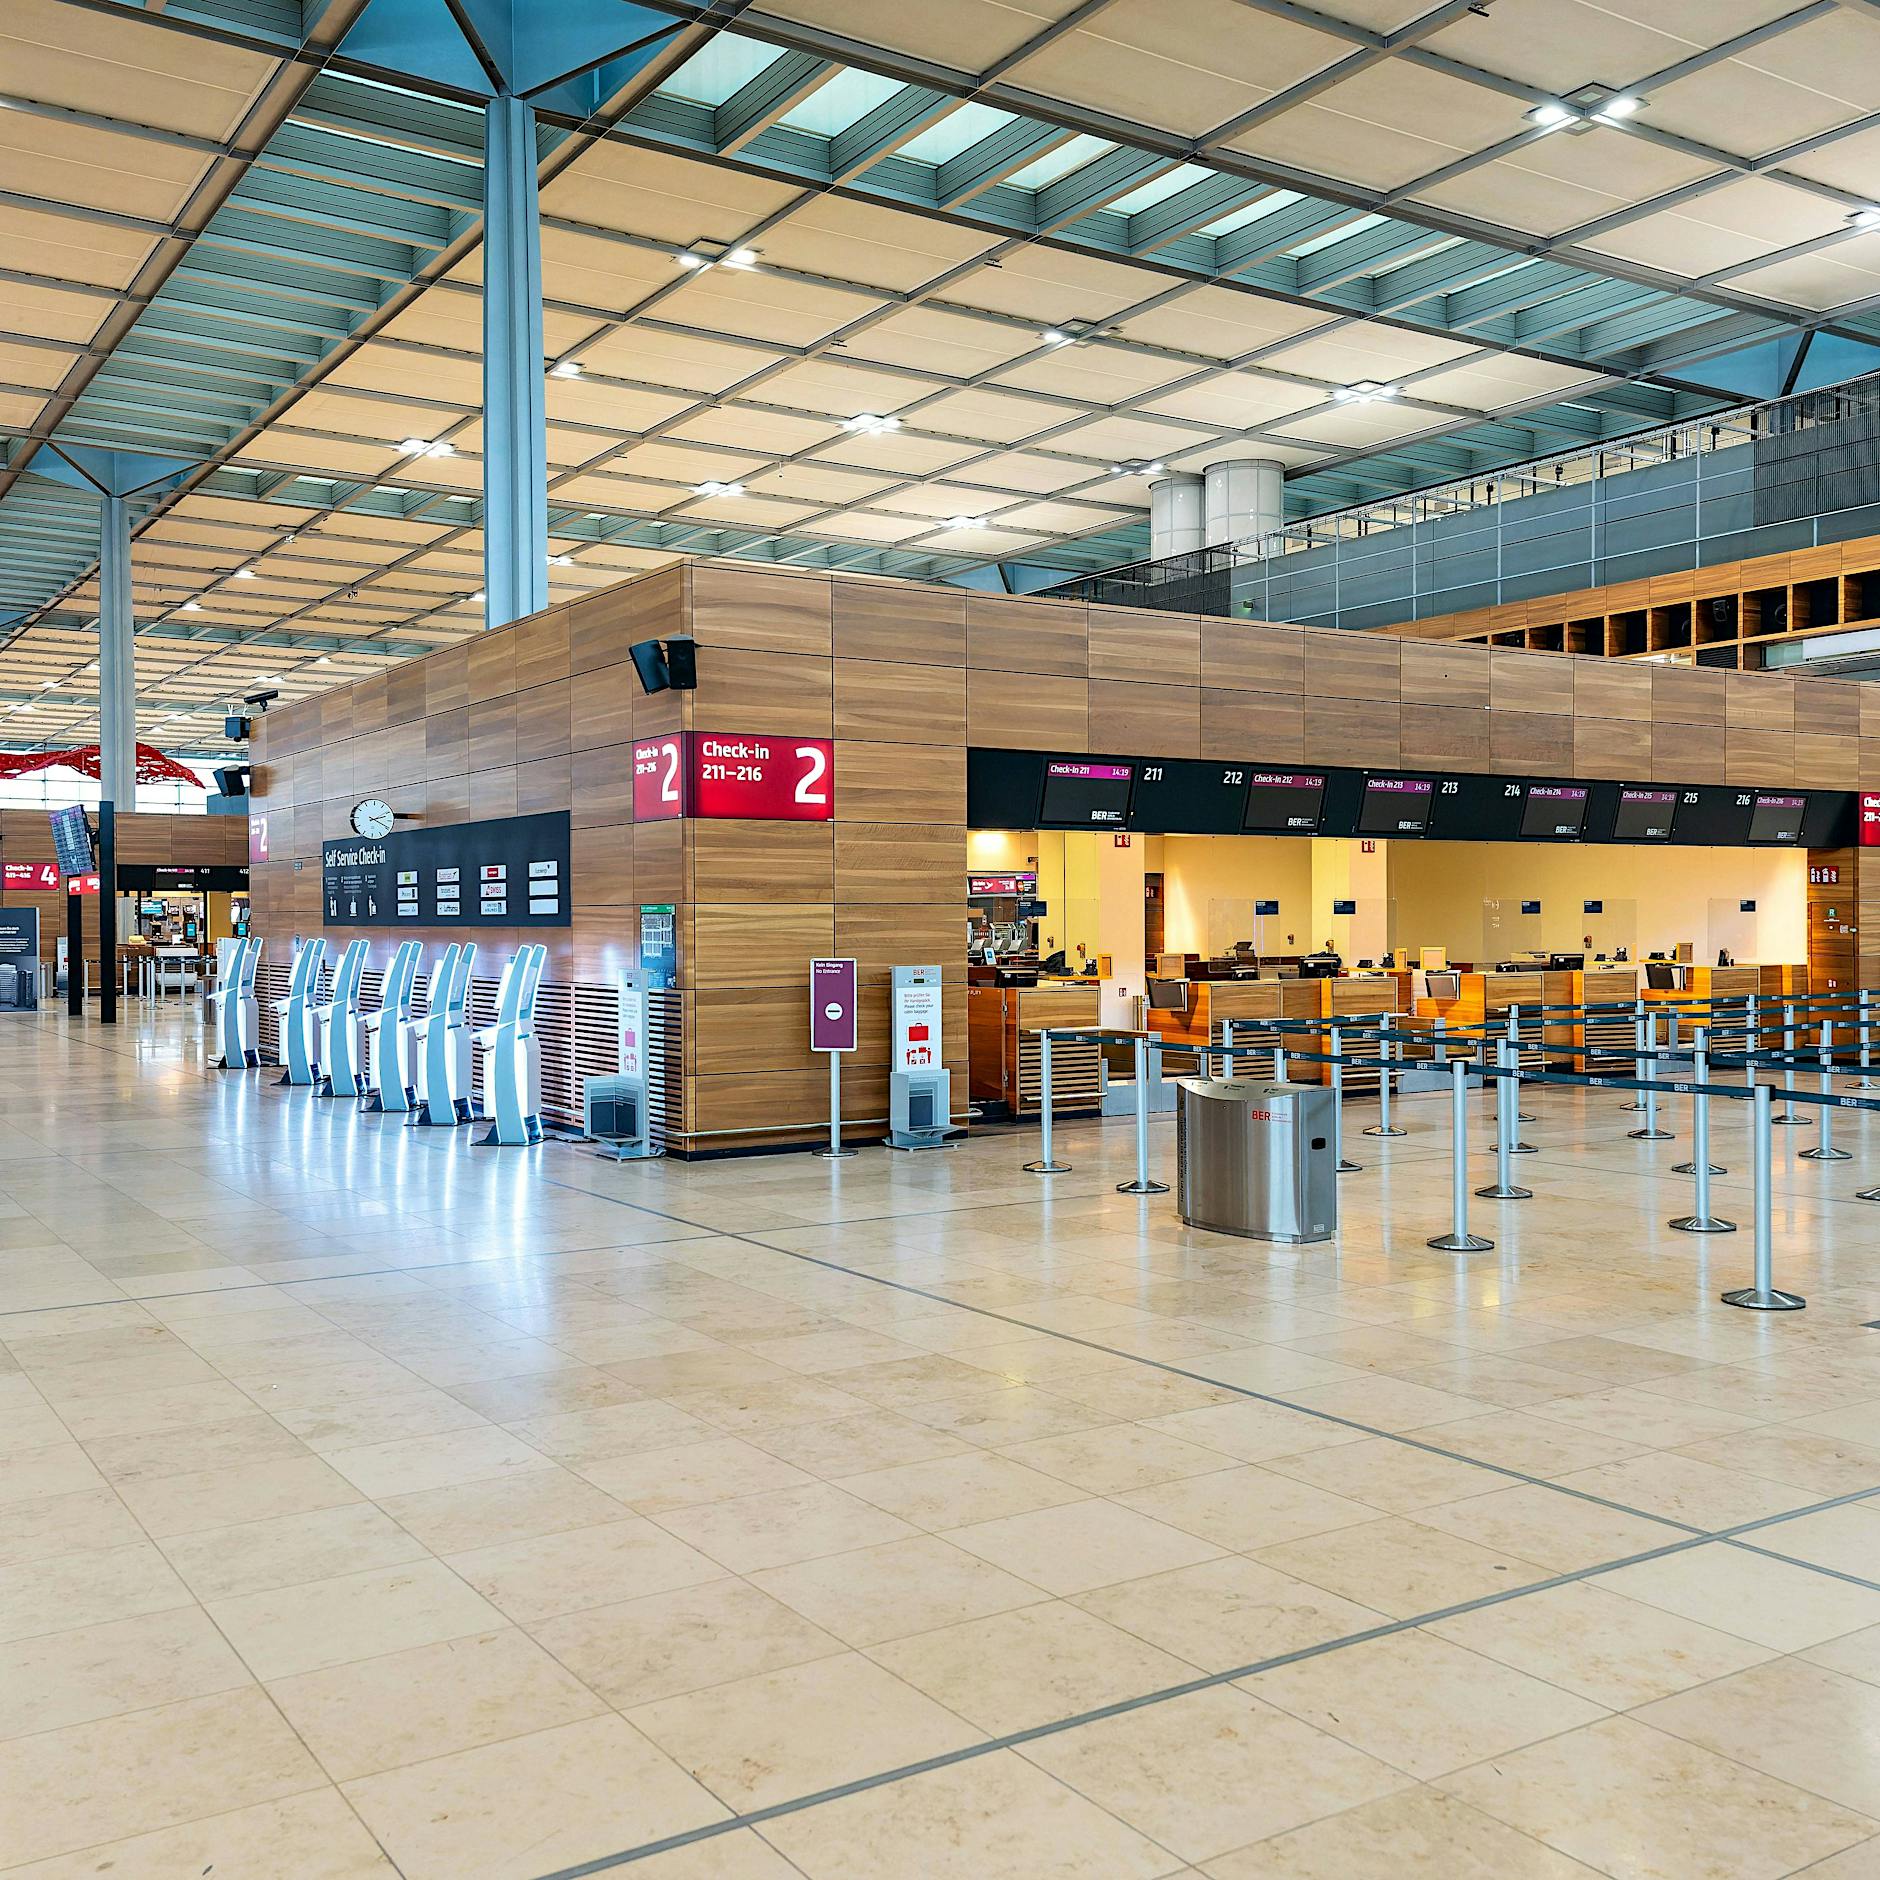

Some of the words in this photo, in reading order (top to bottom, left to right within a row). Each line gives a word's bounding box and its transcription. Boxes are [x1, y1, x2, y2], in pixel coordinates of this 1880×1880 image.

[636, 746, 659, 760] Check-in
[702, 741, 769, 759] Check-in
[662, 743, 679, 801] 2
[702, 764, 762, 781] 211–216
[794, 747, 826, 804] 2
[1050, 765, 1079, 774] Check-In
[1080, 767, 1090, 775] 211
[1112, 768, 1129, 776] 14:19
[1144, 768, 1163, 781] 211
[1223, 771, 1243, 784] 212
[1254, 774, 1281, 783] Check-In
[1282, 776, 1293, 784] 212
[1368, 780, 1393, 789] Check-In
[1393, 781, 1403, 789] 213
[1442, 782, 1459, 794] 213
[1504, 785, 1520, 796] 214
[1684, 792, 1699, 803] 215
[1736, 795, 1751, 805] 216
[1091, 811, 1108, 820] BER
[1288, 818, 1302, 827] BER
[1399, 821, 1411, 830] BER
[260, 818, 267, 852] 2
[326, 849, 336, 867] Self
[337, 848, 358, 866] Service
[359, 845, 386, 865] Check-in
[40, 866, 57, 885] 4
[1674, 1084, 1689, 1092] BER
[1840, 1098, 1858, 1106] BER
[1252, 1110, 1271, 1121] BER
